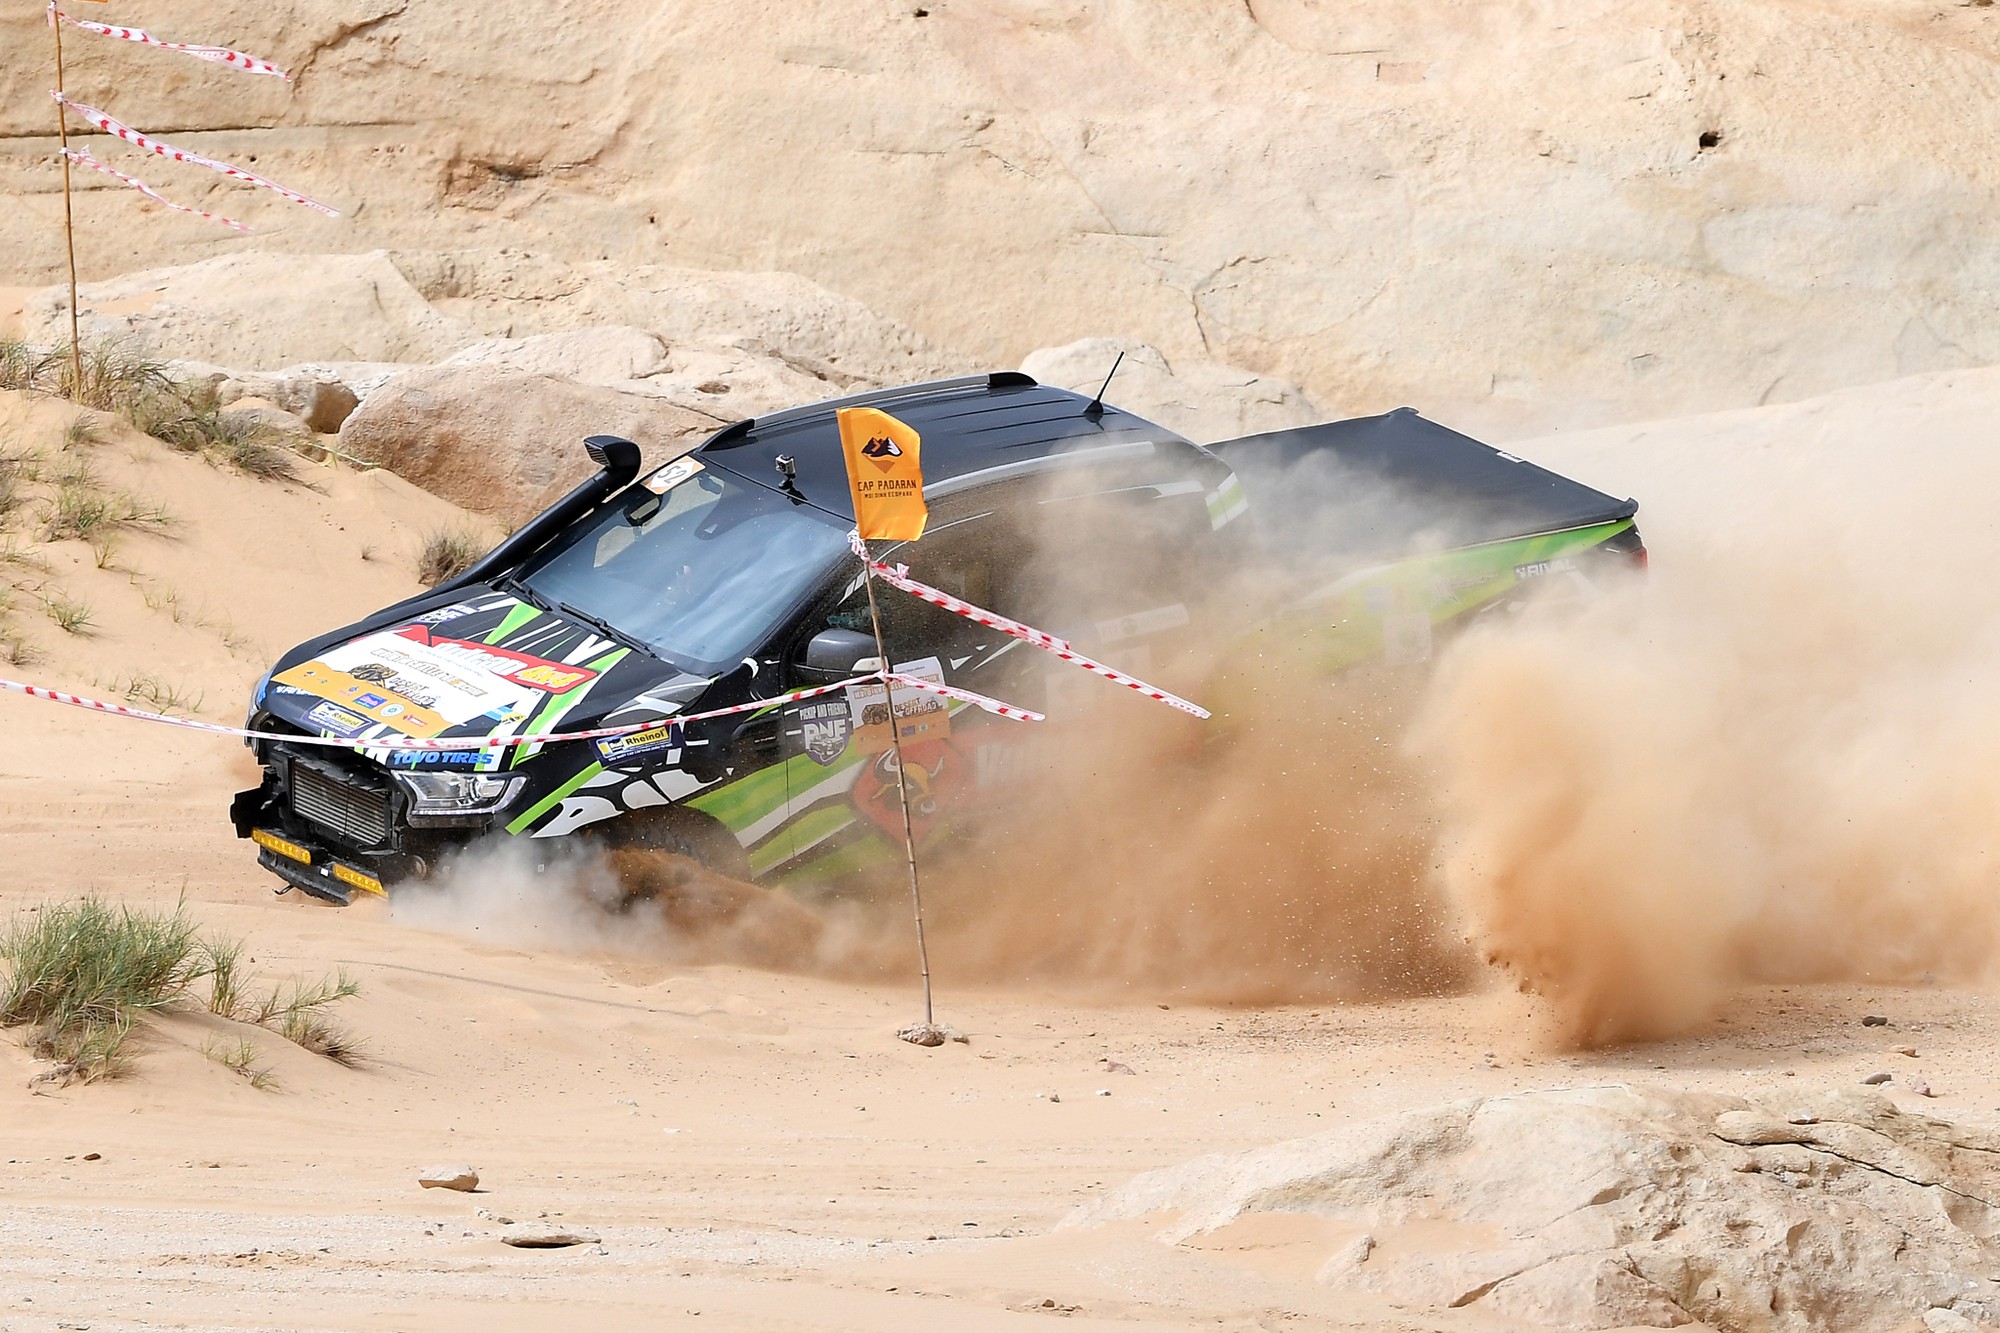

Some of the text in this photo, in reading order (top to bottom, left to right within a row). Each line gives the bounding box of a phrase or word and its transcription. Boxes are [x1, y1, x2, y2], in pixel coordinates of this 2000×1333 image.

[657, 465, 688, 484] 52
[857, 479, 917, 492] CAP PADARAN
[625, 730, 664, 746] Rheinol
[441, 751, 494, 765] TIRES
